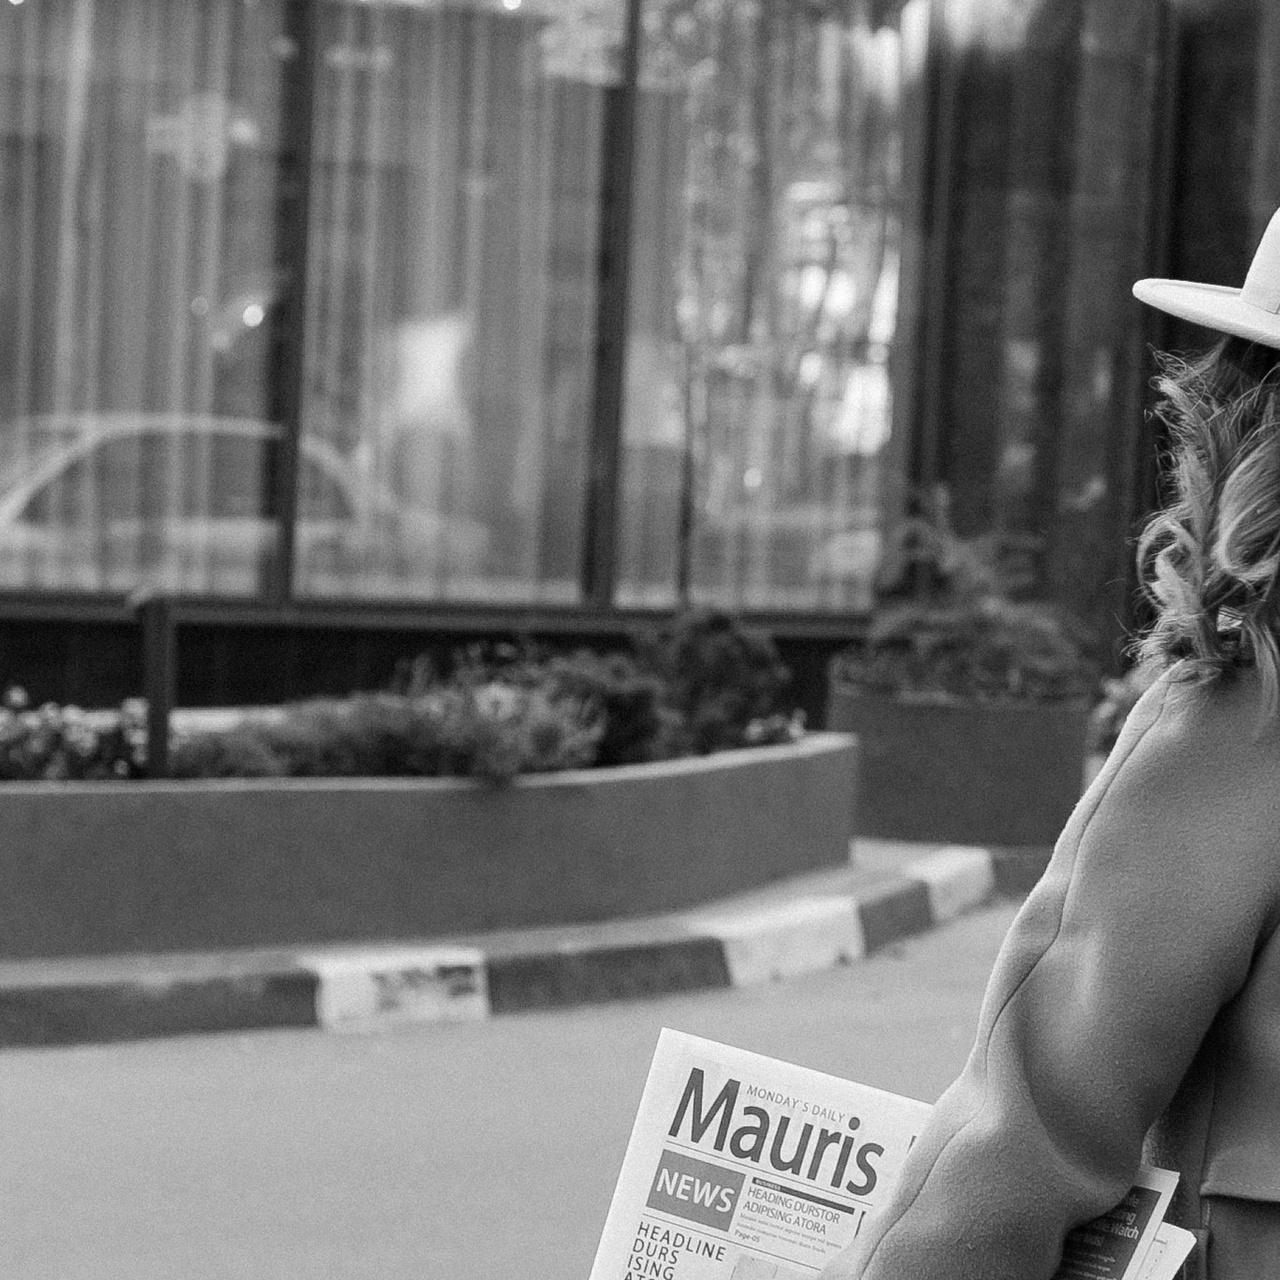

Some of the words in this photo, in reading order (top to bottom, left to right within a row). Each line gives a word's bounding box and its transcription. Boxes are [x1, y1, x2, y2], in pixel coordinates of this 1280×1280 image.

[668, 1067, 884, 1196] Mauris
[811, 1104, 846, 1123] DAILY
[656, 1168, 737, 1215] NEWS
[747, 1186, 794, 1209] HEADING
[794, 1201, 841, 1224] DURSTOR
[742, 1201, 793, 1224] ADIPISING
[793, 1216, 826, 1235] ATORA
[632, 1238, 679, 1264] DURS
[637, 1221, 726, 1262] HEADLINE
[627, 1254, 675, 1280] ISING
